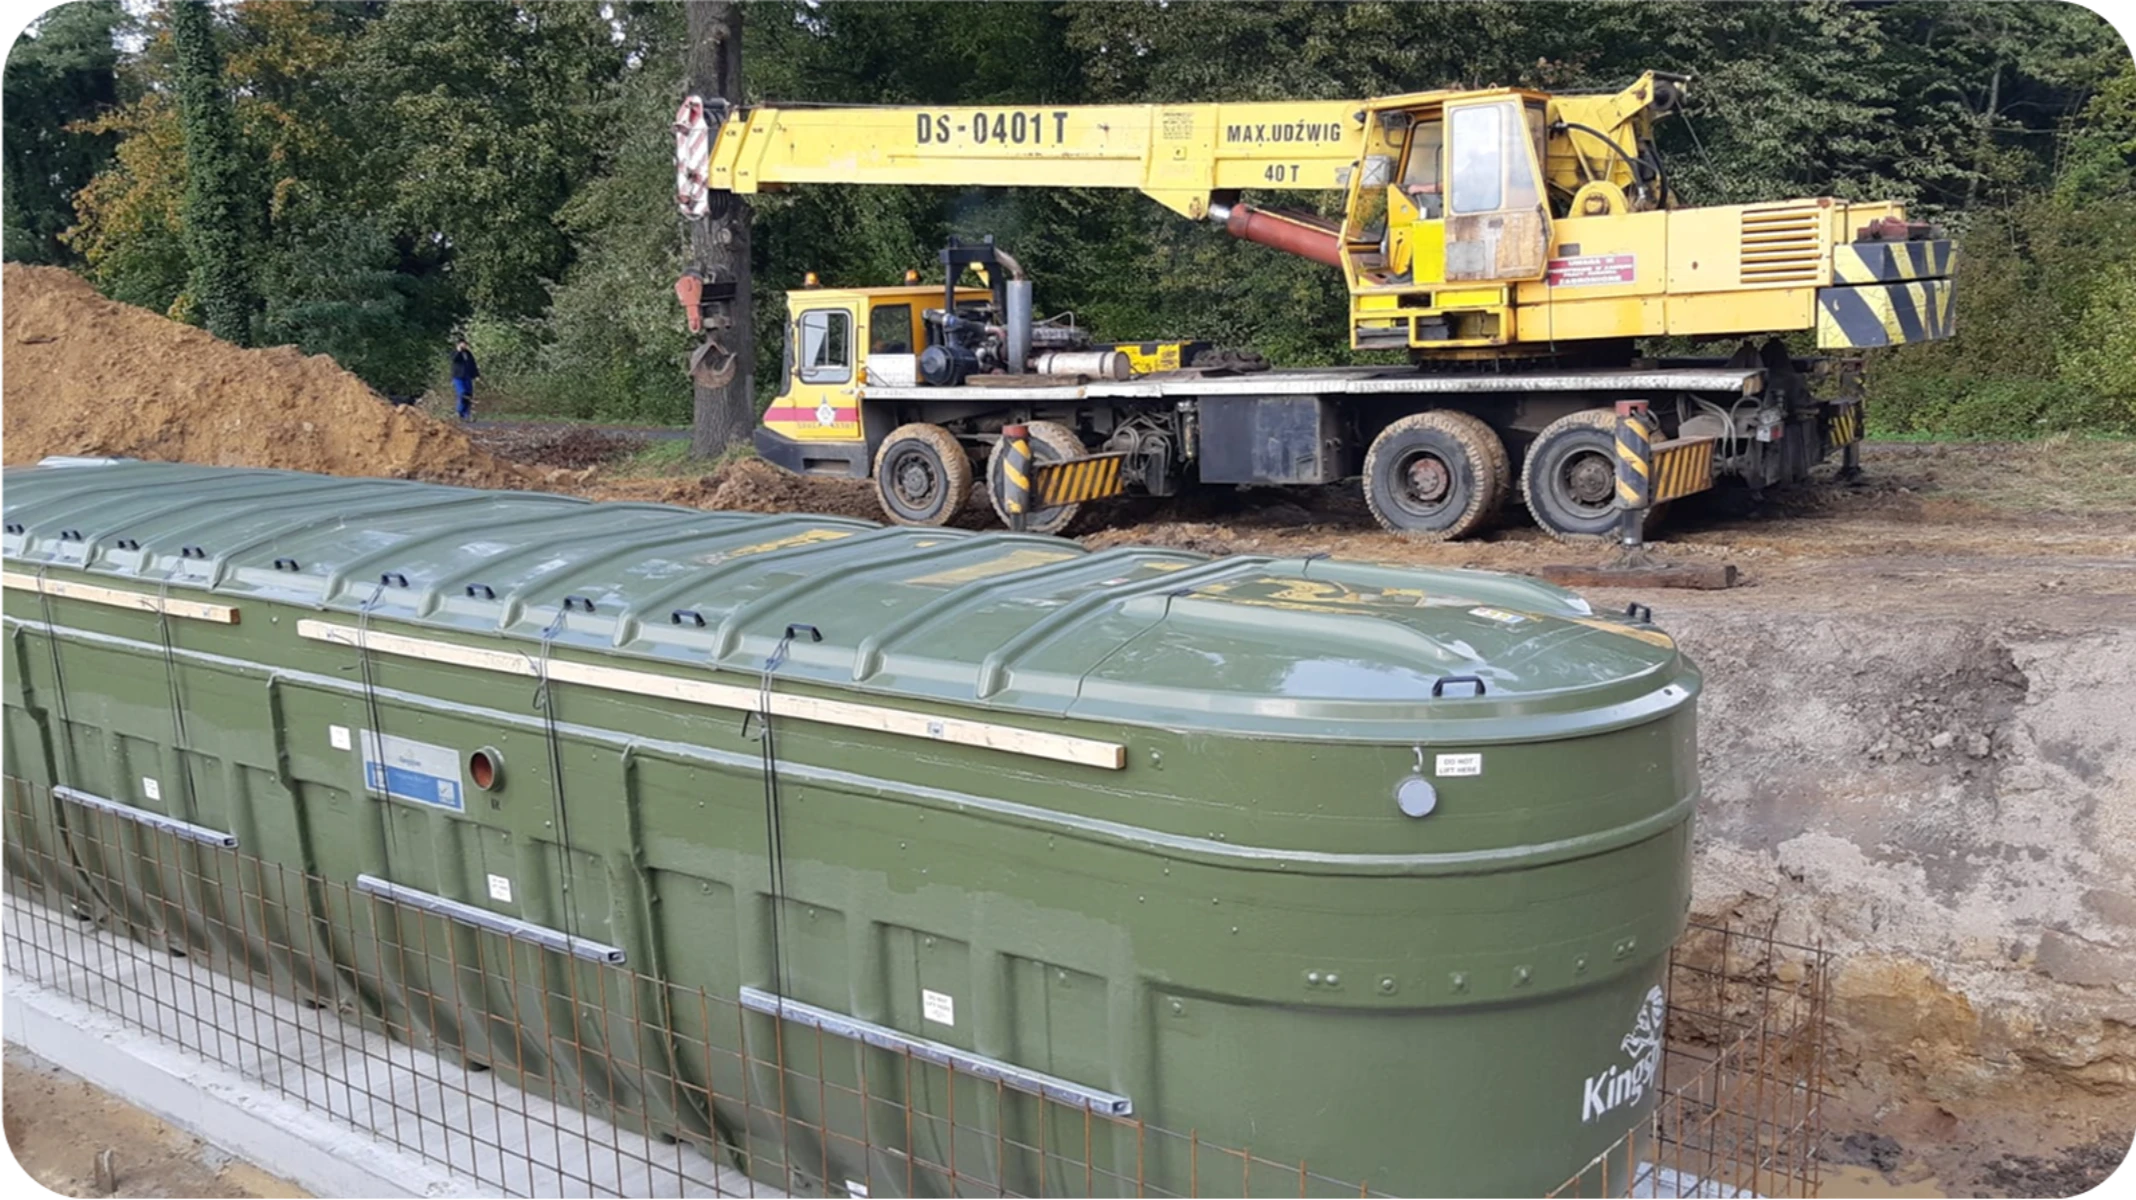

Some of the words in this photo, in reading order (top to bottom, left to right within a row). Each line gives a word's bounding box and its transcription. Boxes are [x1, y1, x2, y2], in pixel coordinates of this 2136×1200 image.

[917, 111, 1041, 144] DS-0401
[1053, 111, 1068, 144] T
[1227, 119, 1341, 142] MAX.UDŹWIG
[1264, 164, 1285, 182] 40
[1289, 164, 1300, 182] T
